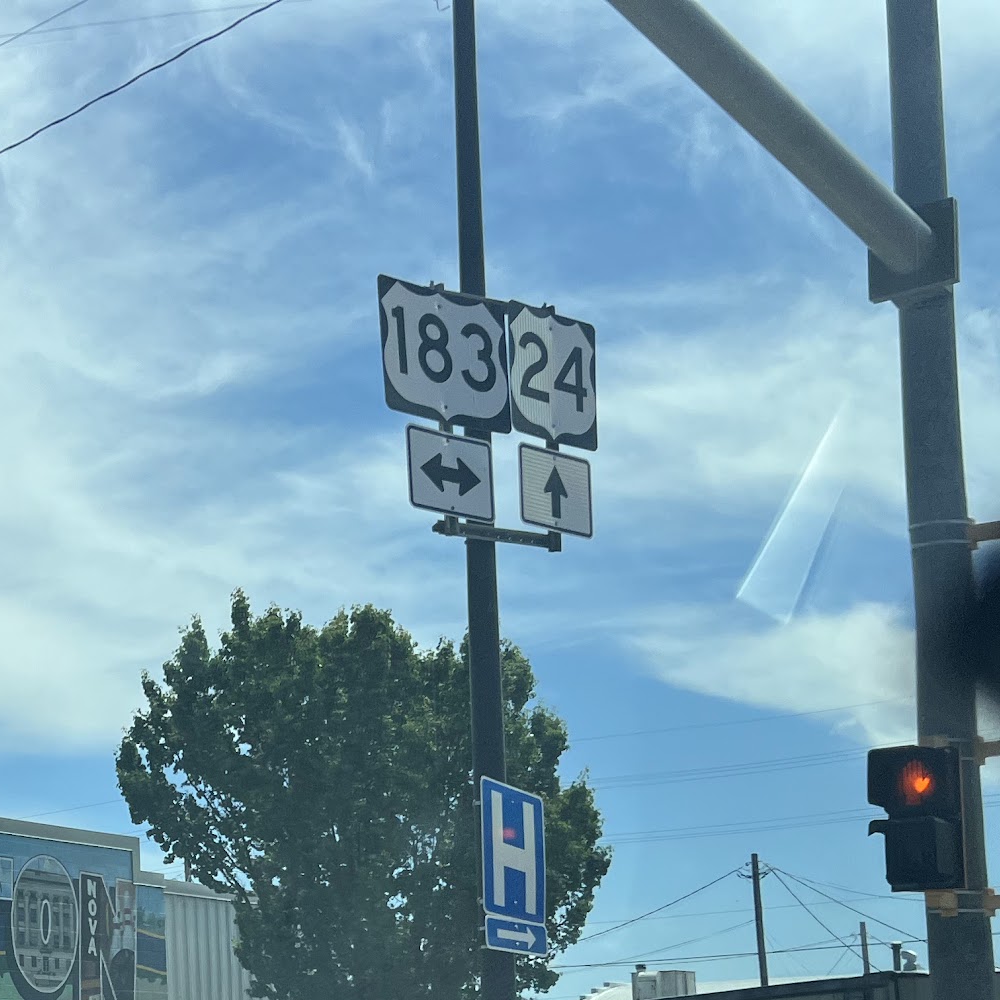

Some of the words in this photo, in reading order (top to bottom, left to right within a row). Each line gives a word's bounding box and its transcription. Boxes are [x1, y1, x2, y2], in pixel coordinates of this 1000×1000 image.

[391, 305, 497, 393] 183
[518, 331, 588, 413] 24
[490, 789, 537, 915] H
[86, 878, 98, 957] NOVA
